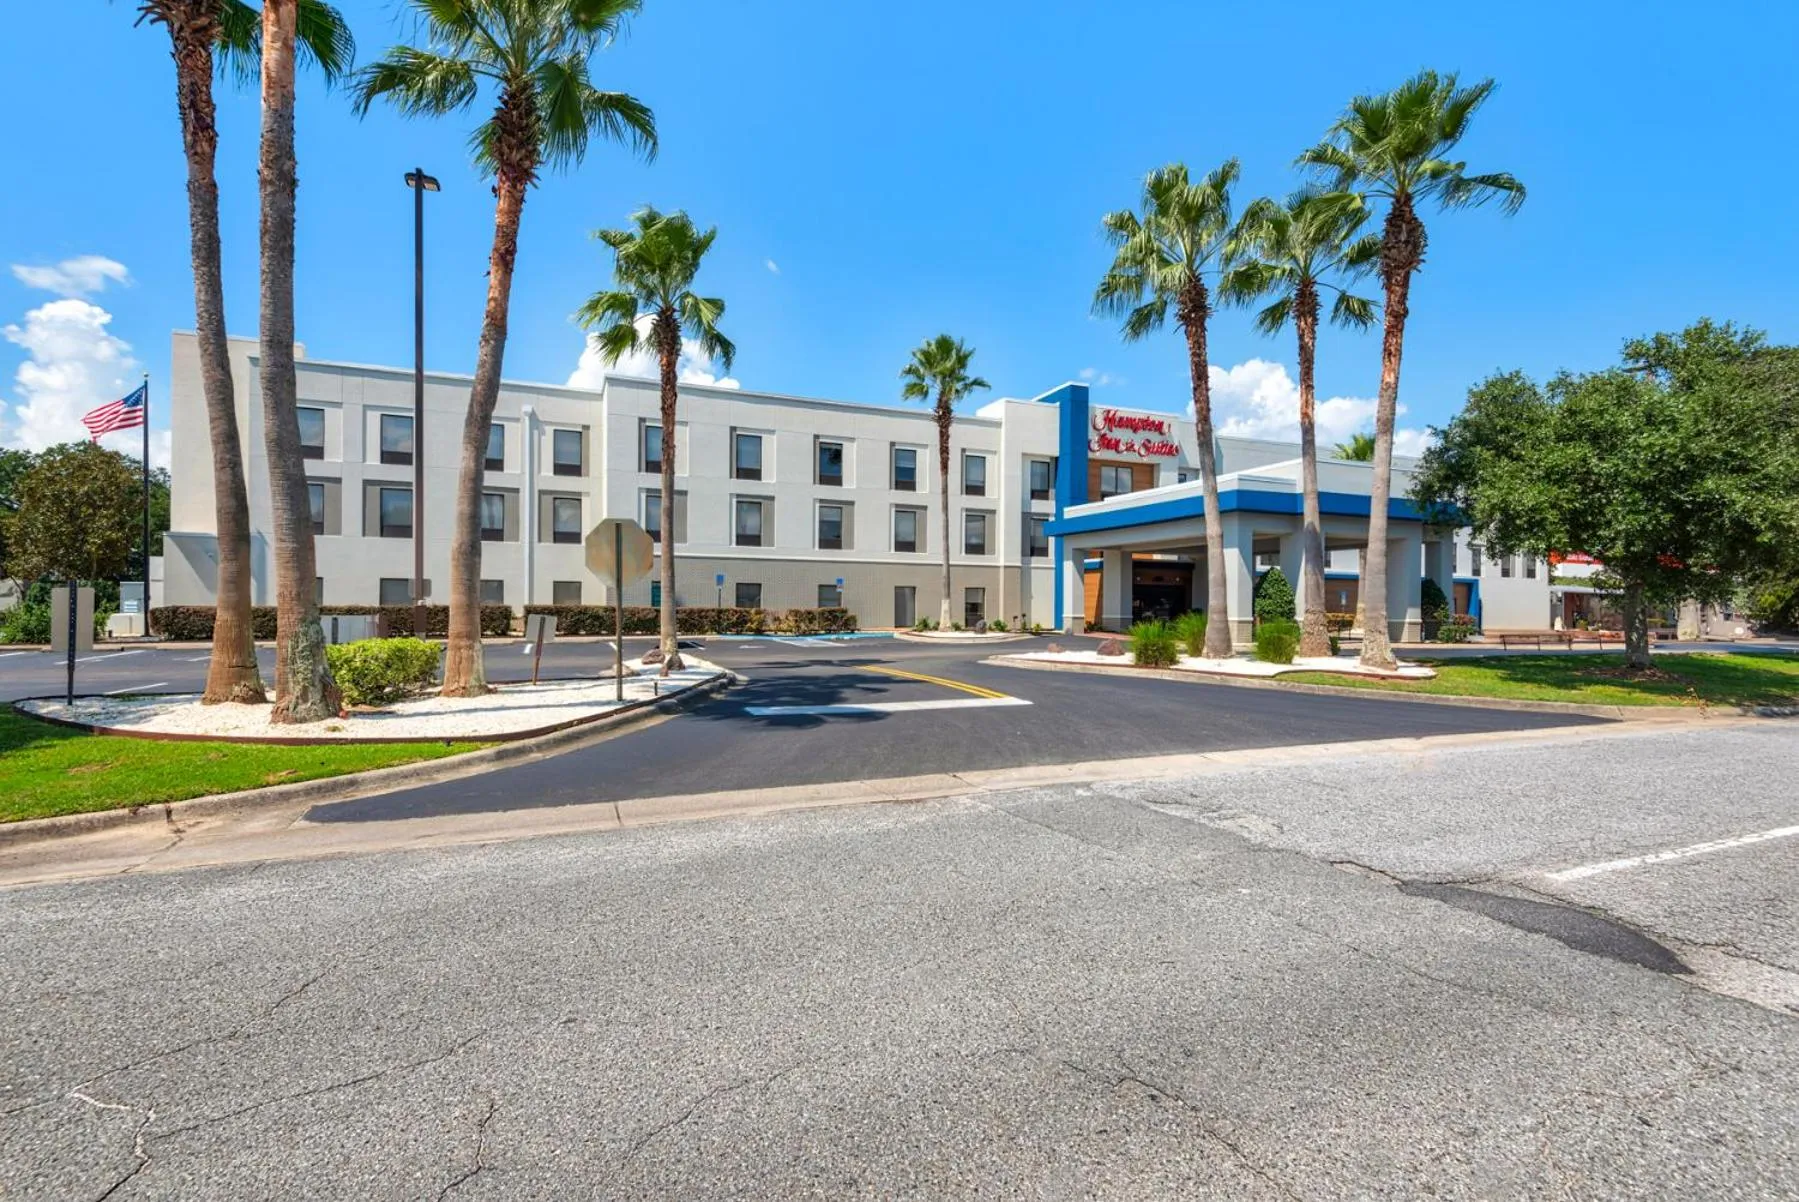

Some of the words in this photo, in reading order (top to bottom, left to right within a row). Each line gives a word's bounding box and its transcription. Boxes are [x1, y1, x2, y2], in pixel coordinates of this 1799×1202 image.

[1092, 409, 1166, 435] Hampton
[1089, 433, 1125, 453] Inn
[1138, 439, 1179, 457] Suites
